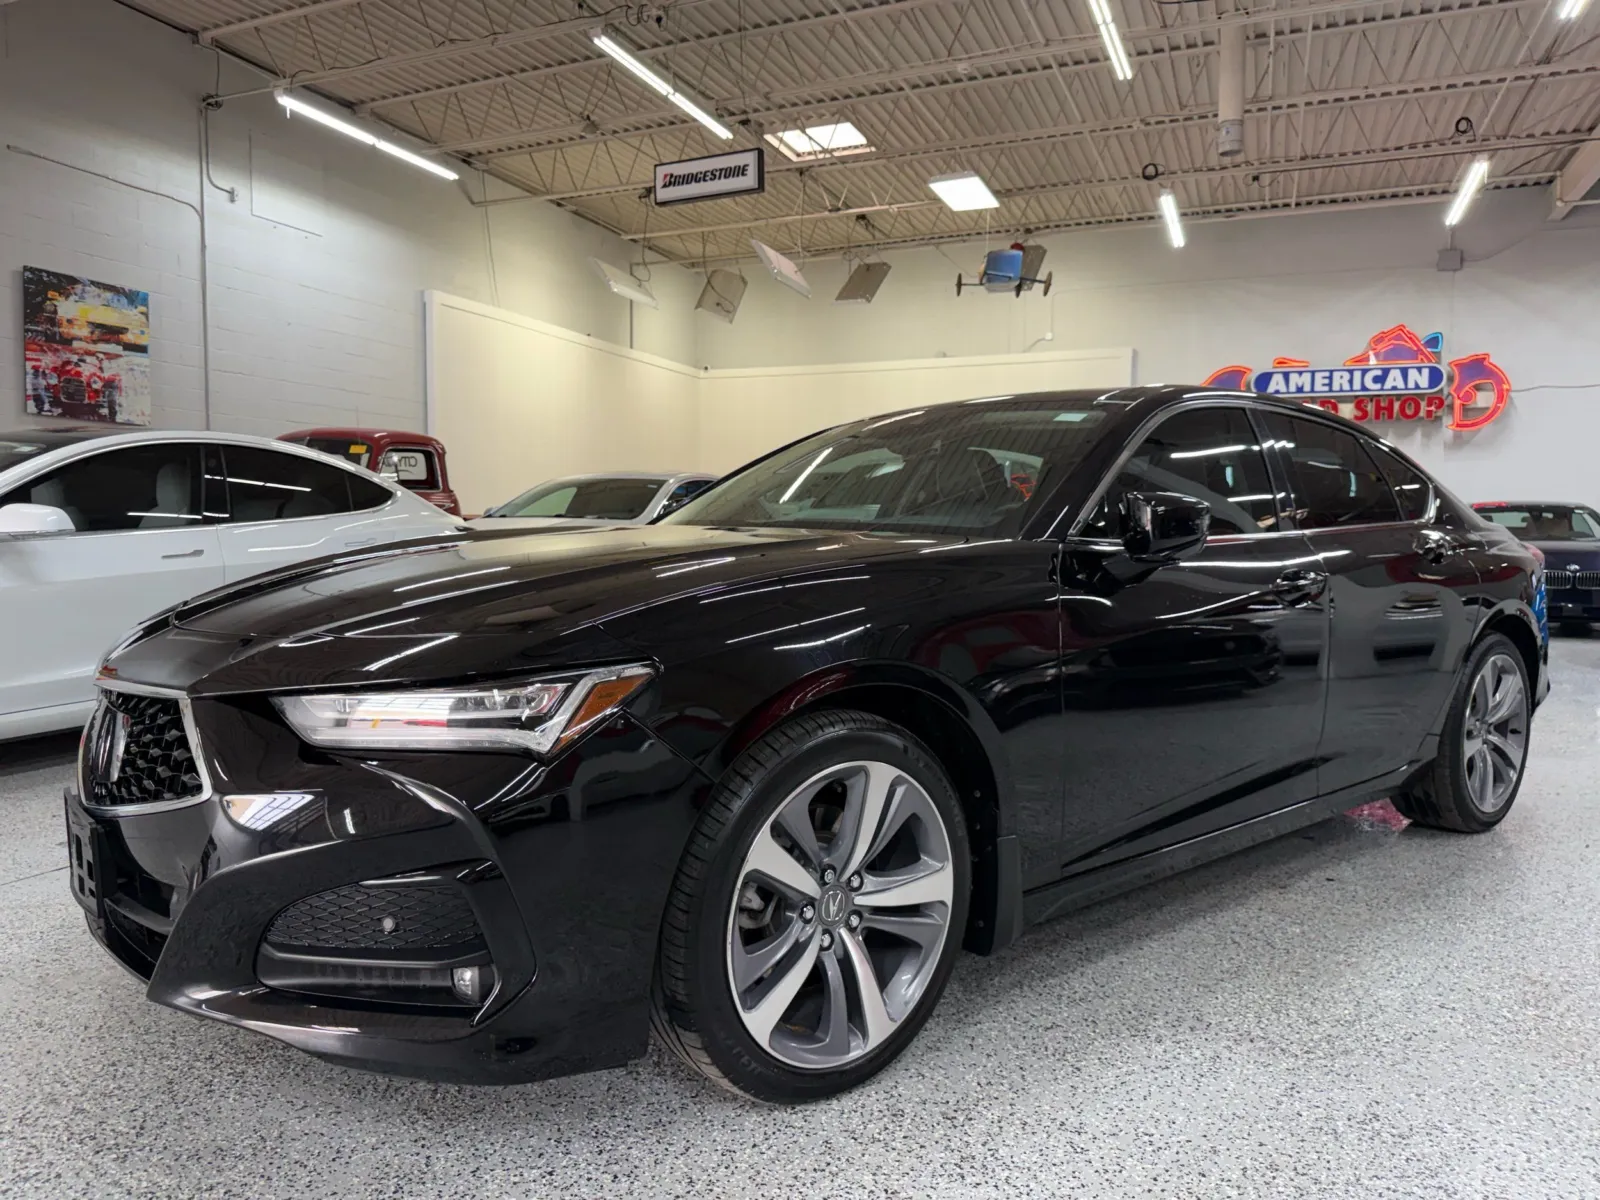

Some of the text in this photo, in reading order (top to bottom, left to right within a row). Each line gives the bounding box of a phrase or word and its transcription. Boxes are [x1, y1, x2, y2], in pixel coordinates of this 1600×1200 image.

[661, 164, 749, 189] BRIDGESTONE
[1266, 368, 1429, 393] AMERICAN
[1353, 395, 1445, 422] SHOP
